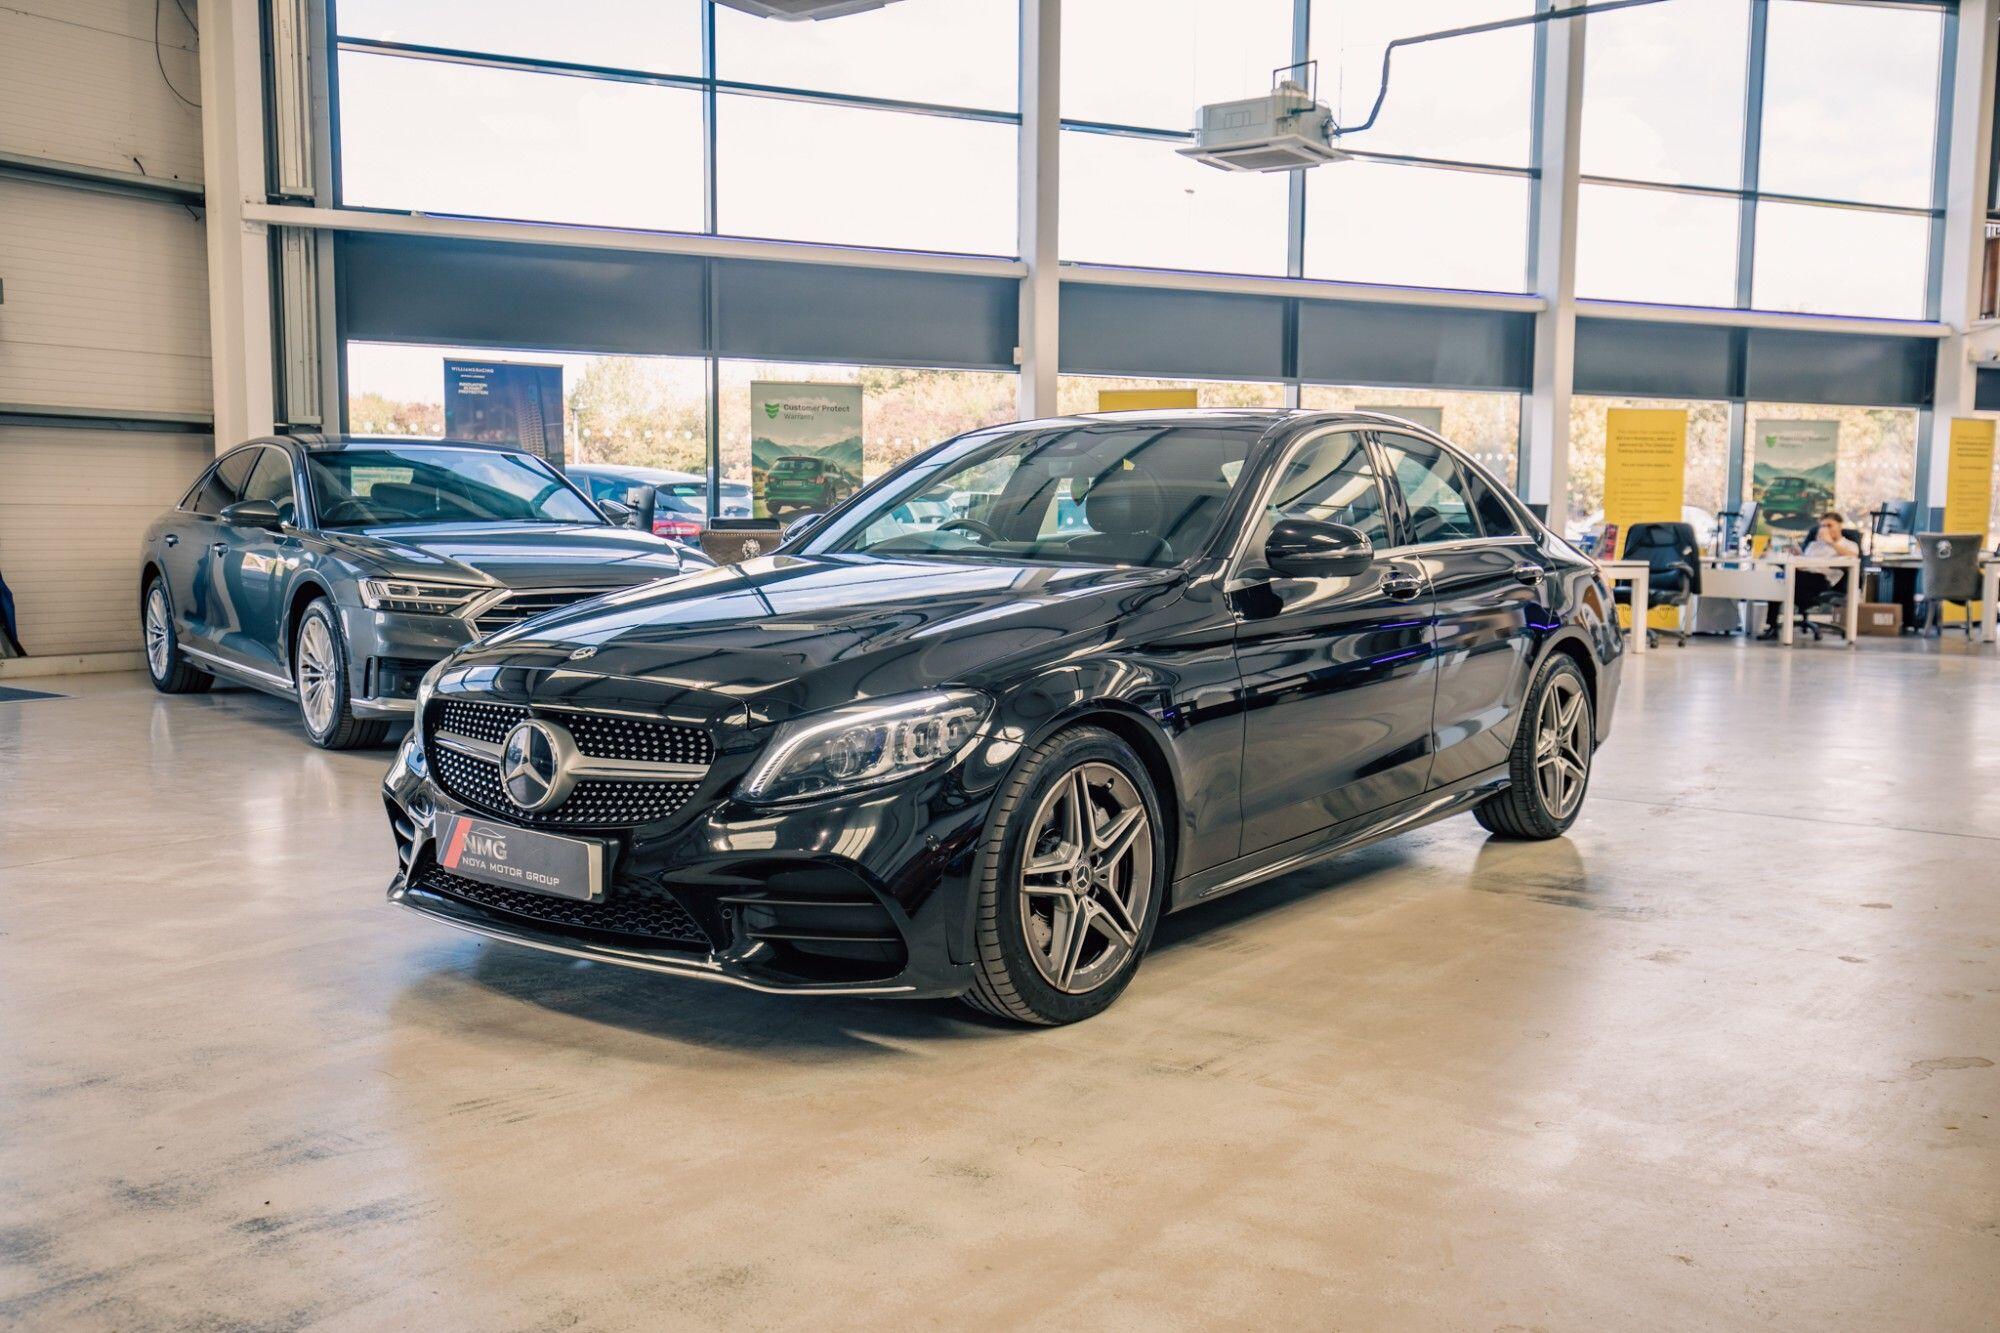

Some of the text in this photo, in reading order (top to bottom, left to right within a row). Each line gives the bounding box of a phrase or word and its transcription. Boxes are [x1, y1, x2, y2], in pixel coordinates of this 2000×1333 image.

[463, 833, 507, 860] NMG
[462, 857, 560, 886] NOYA MOTOR GROUP
